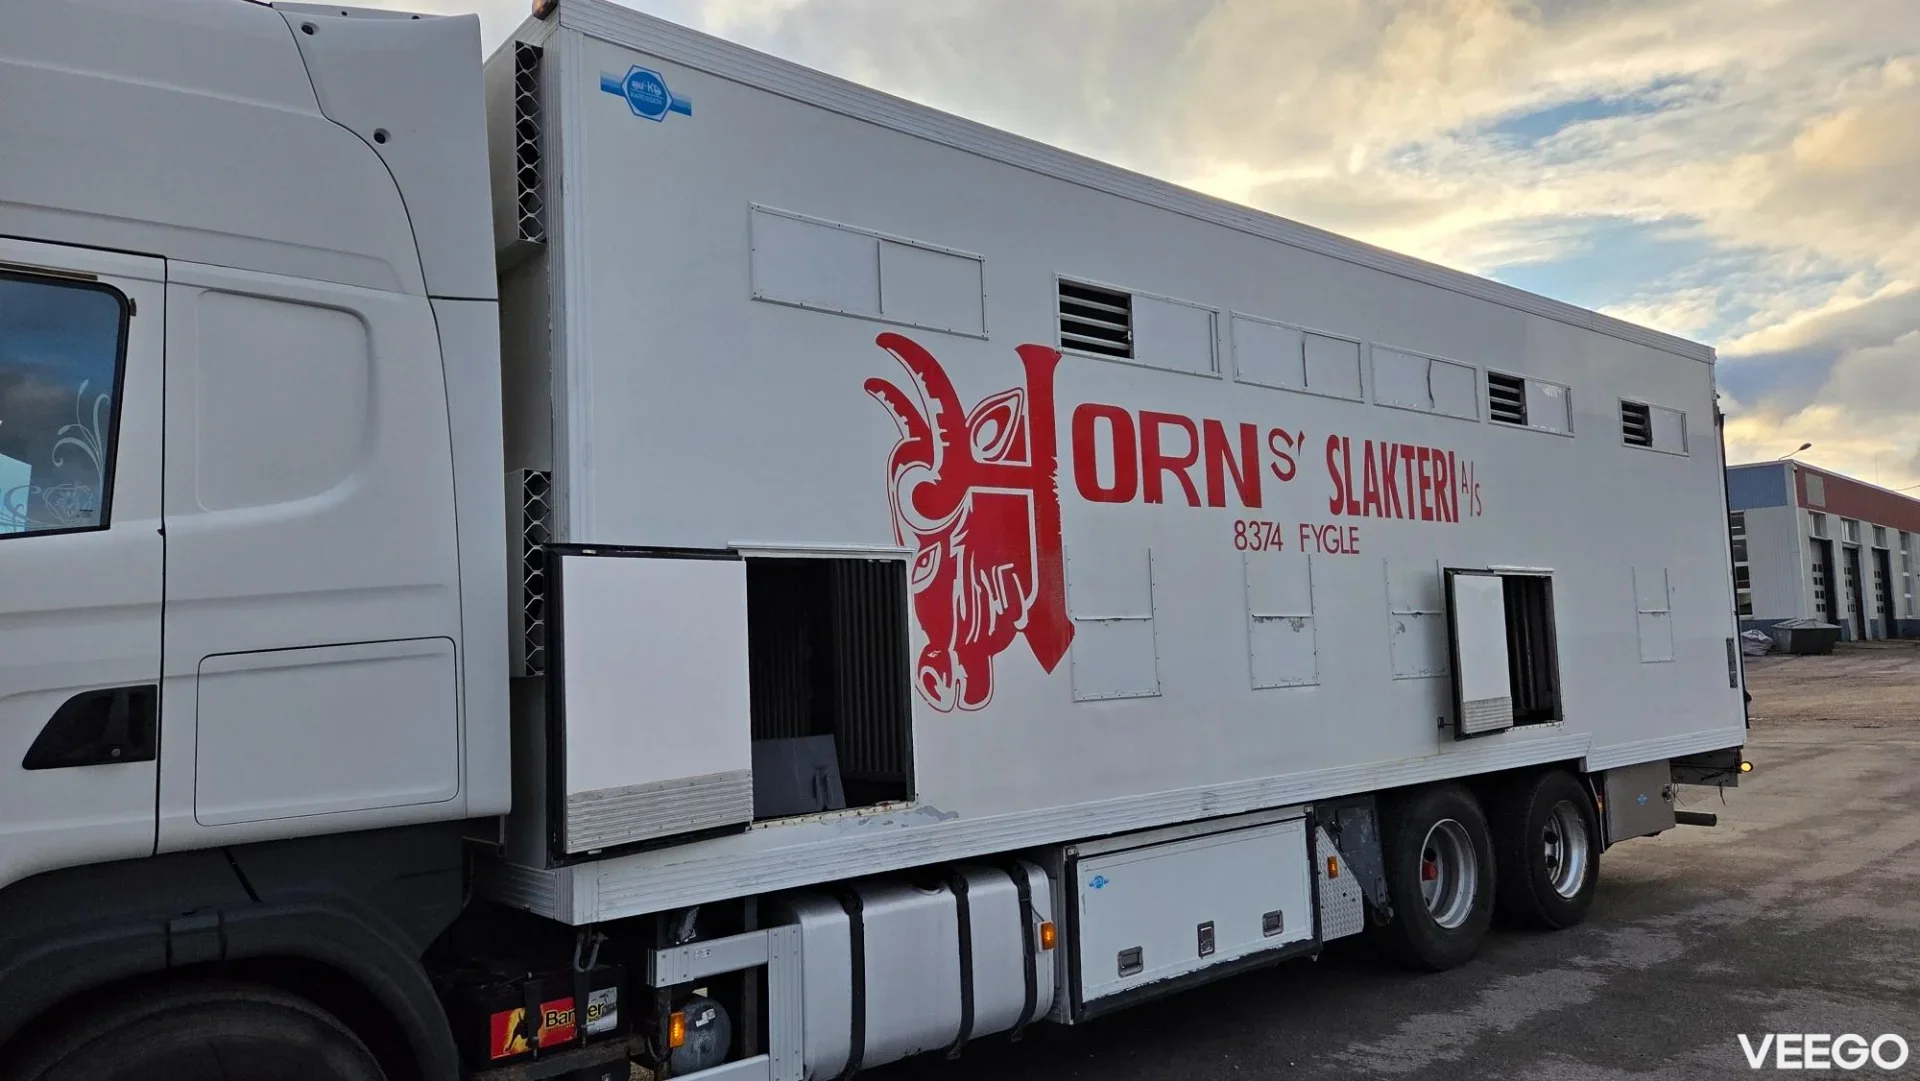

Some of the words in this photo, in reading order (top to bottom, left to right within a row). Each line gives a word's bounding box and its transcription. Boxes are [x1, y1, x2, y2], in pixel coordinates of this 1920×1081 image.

[1326, 434, 1459, 523] SLAKTERI
[1461, 460, 1482, 517] A/S
[1234, 520, 1283, 551] 8374
[1299, 523, 1360, 554] FYGLE
